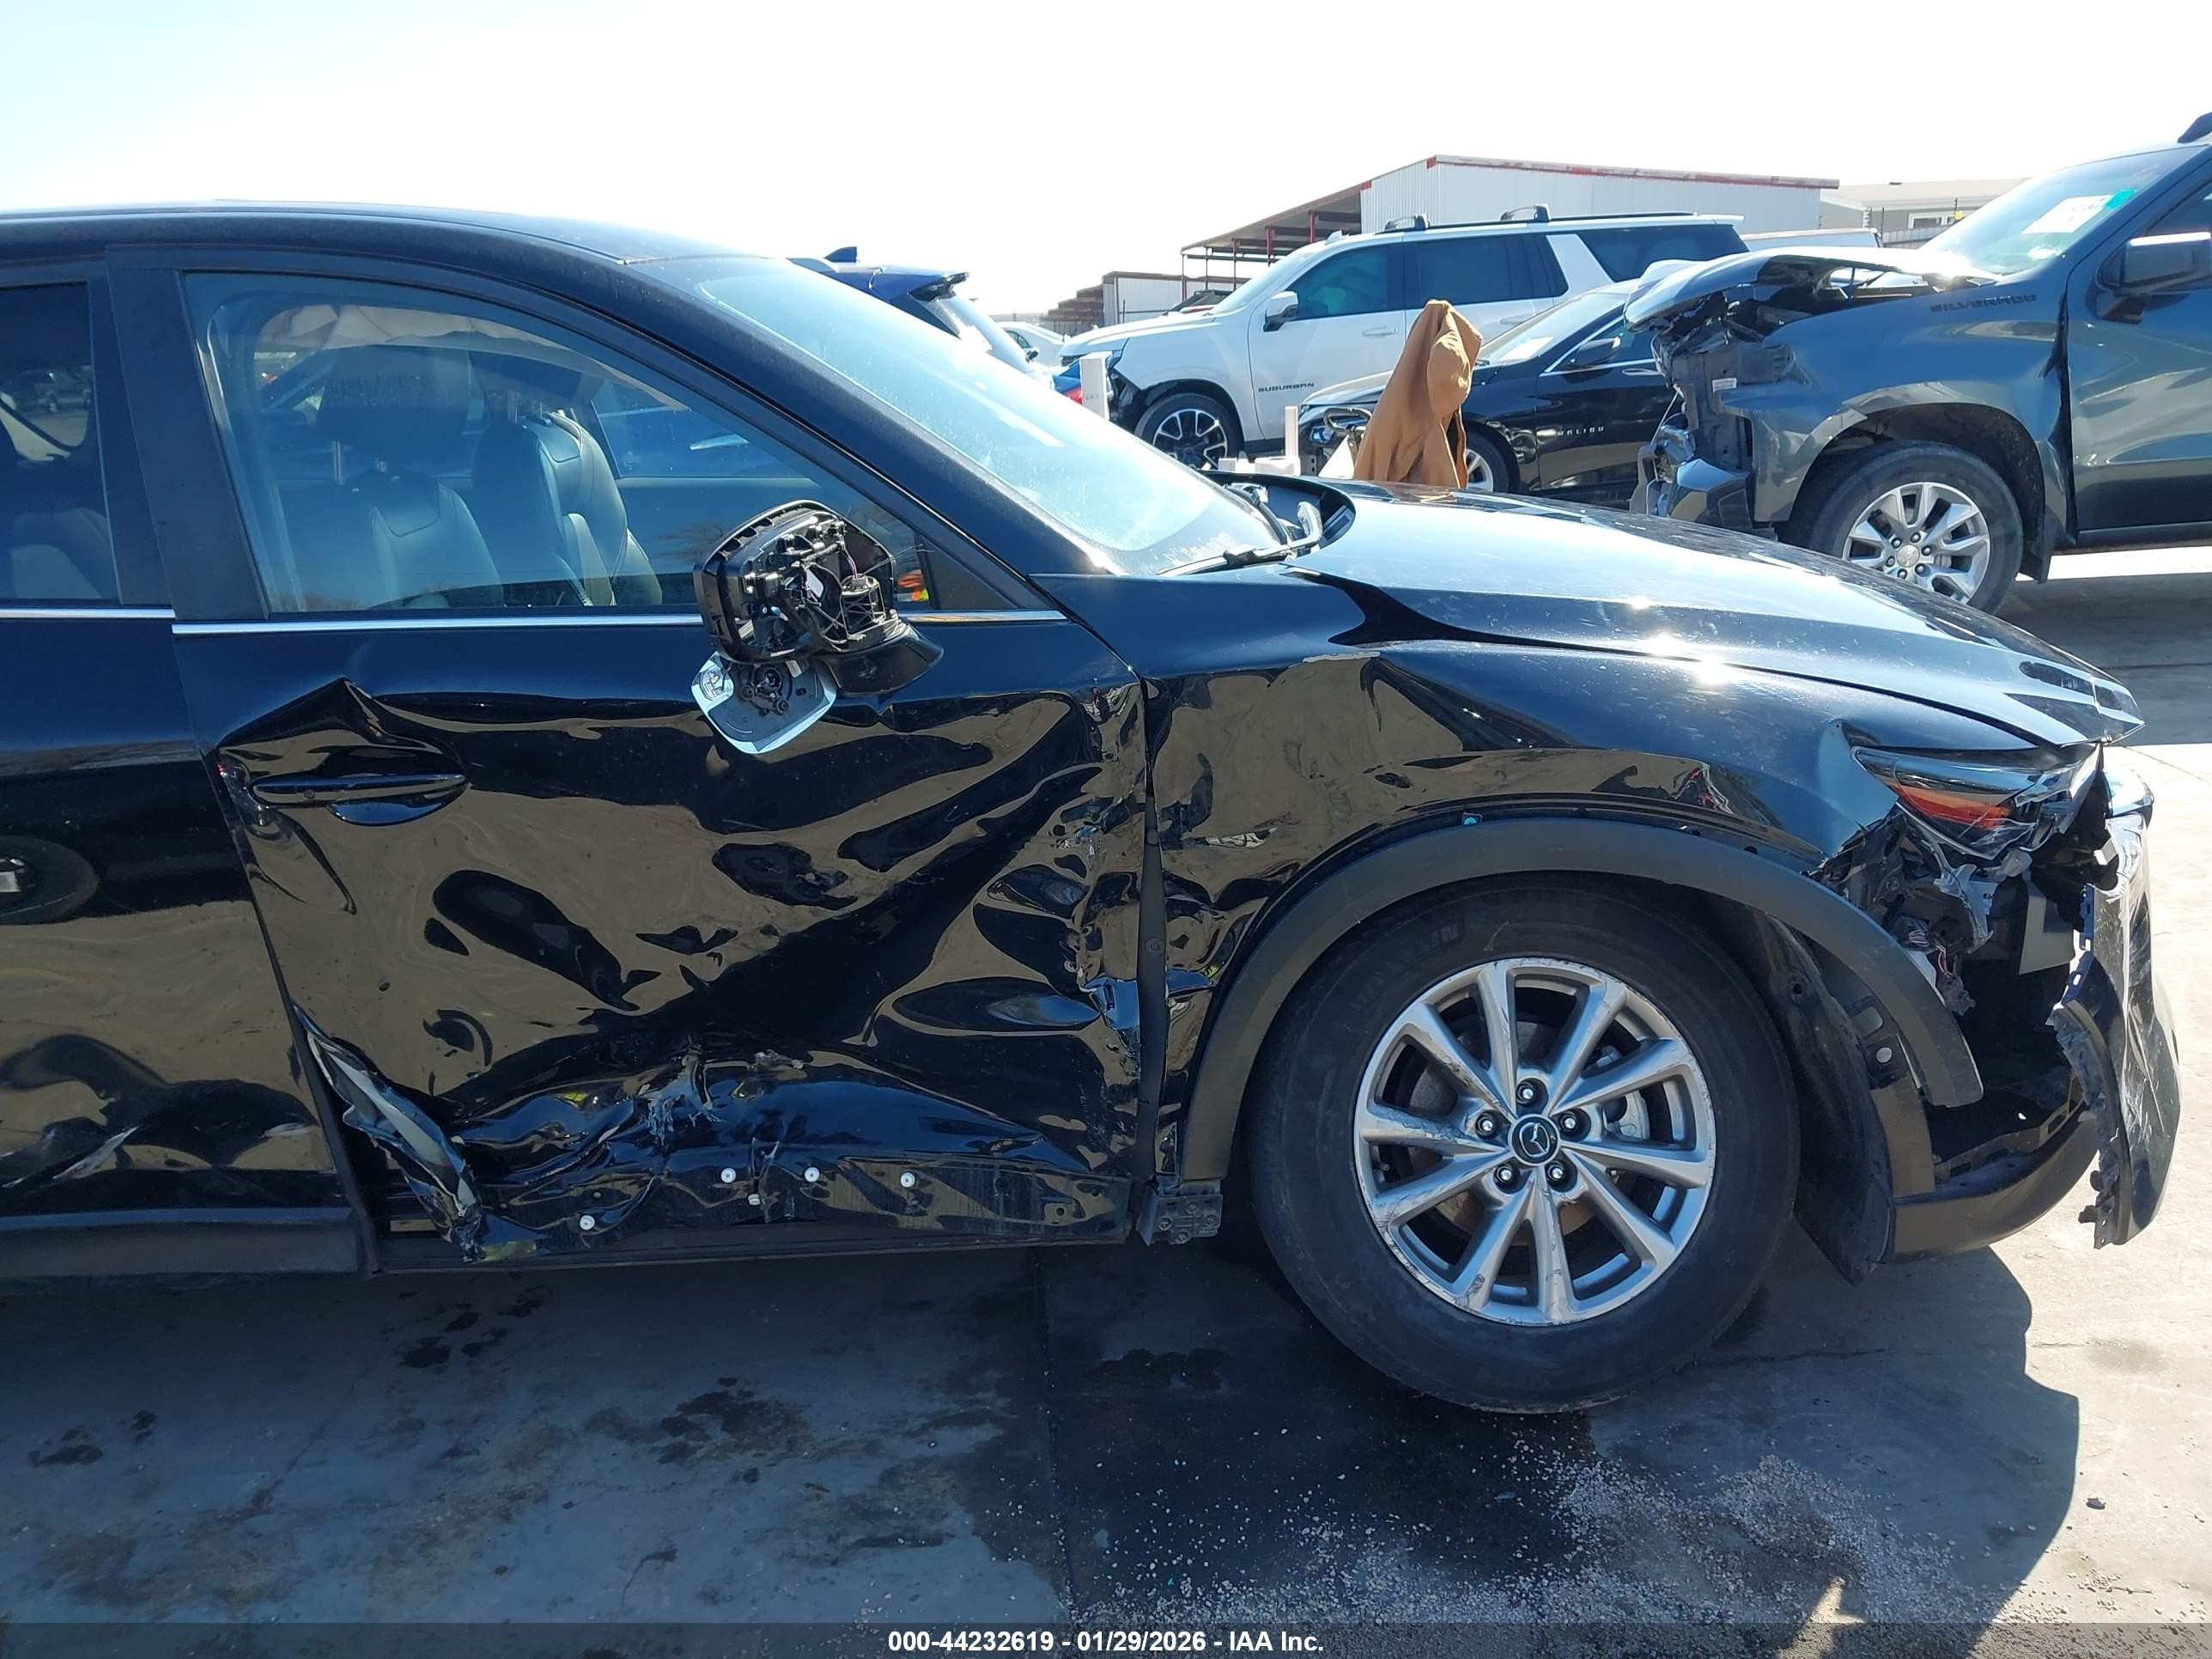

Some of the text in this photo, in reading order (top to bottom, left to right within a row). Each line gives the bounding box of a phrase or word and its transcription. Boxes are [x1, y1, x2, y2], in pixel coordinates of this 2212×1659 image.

[1930, 295, 2036, 313] SILVERADO
[1258, 382, 1314, 392] SUBURBAN
[1557, 426, 1604, 436] MALIBU
